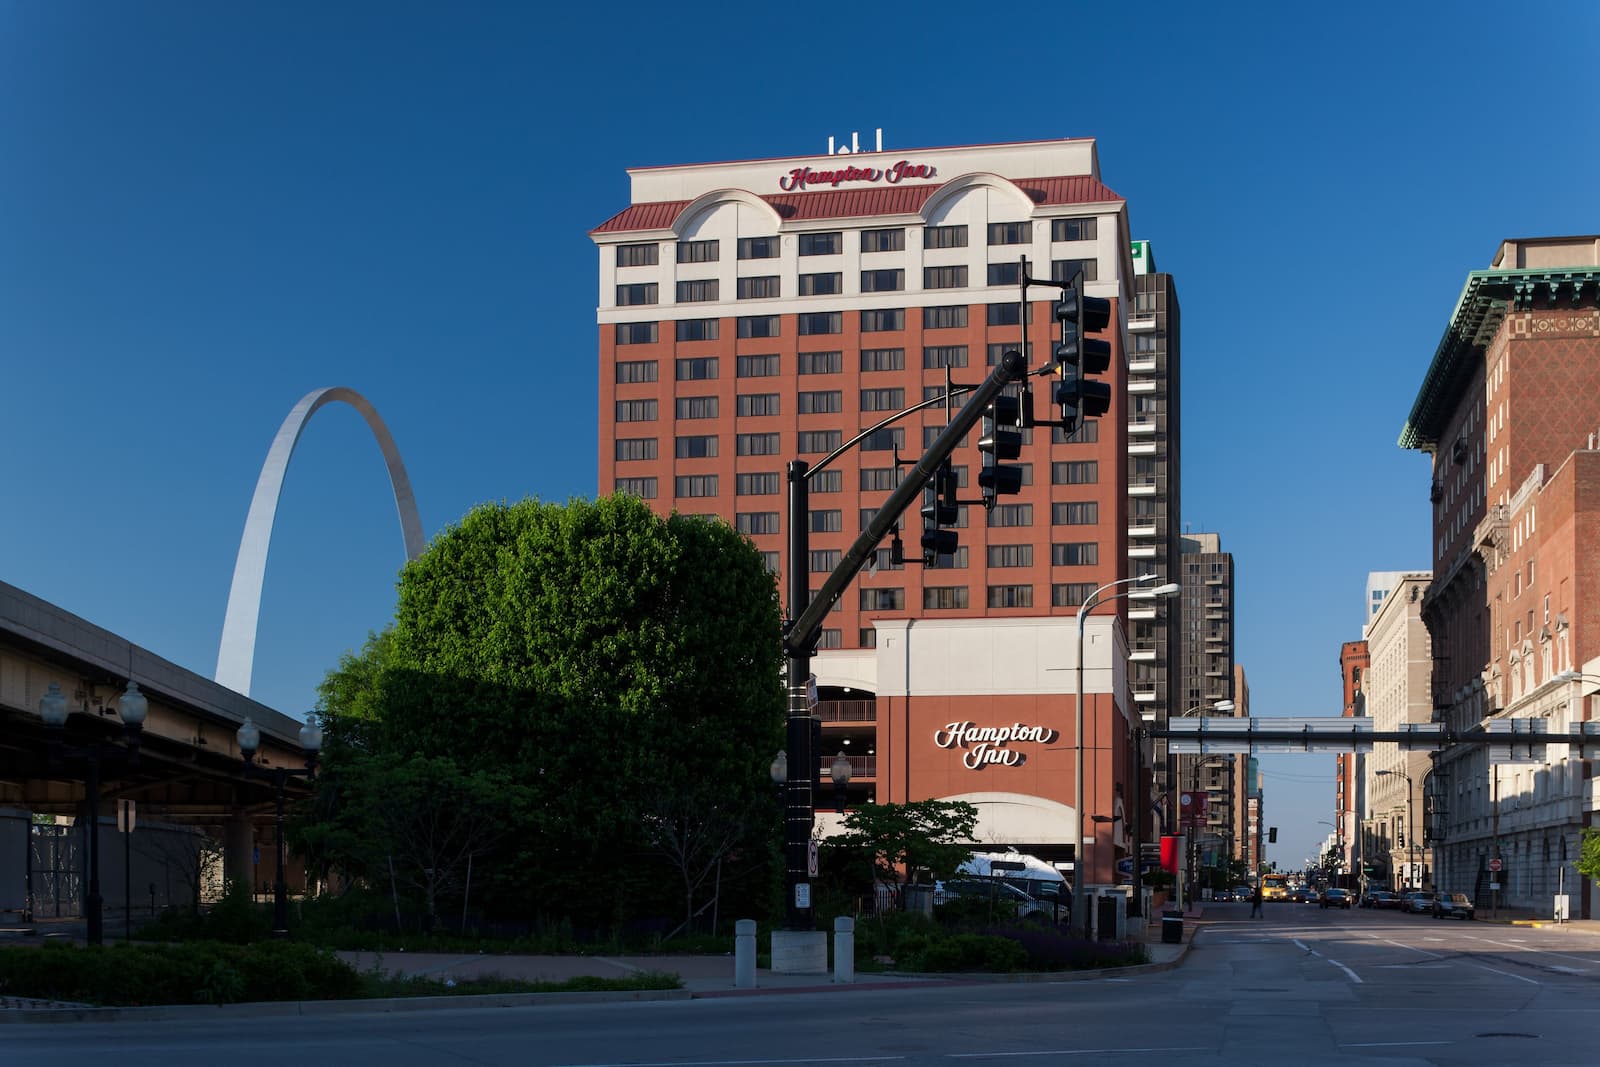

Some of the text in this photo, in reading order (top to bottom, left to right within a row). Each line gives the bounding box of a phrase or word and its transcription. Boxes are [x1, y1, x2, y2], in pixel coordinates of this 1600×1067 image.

[779, 160, 935, 192] Hampton Inn
[934, 720, 1053, 748] Hampton
[962, 743, 1020, 770] Inn
